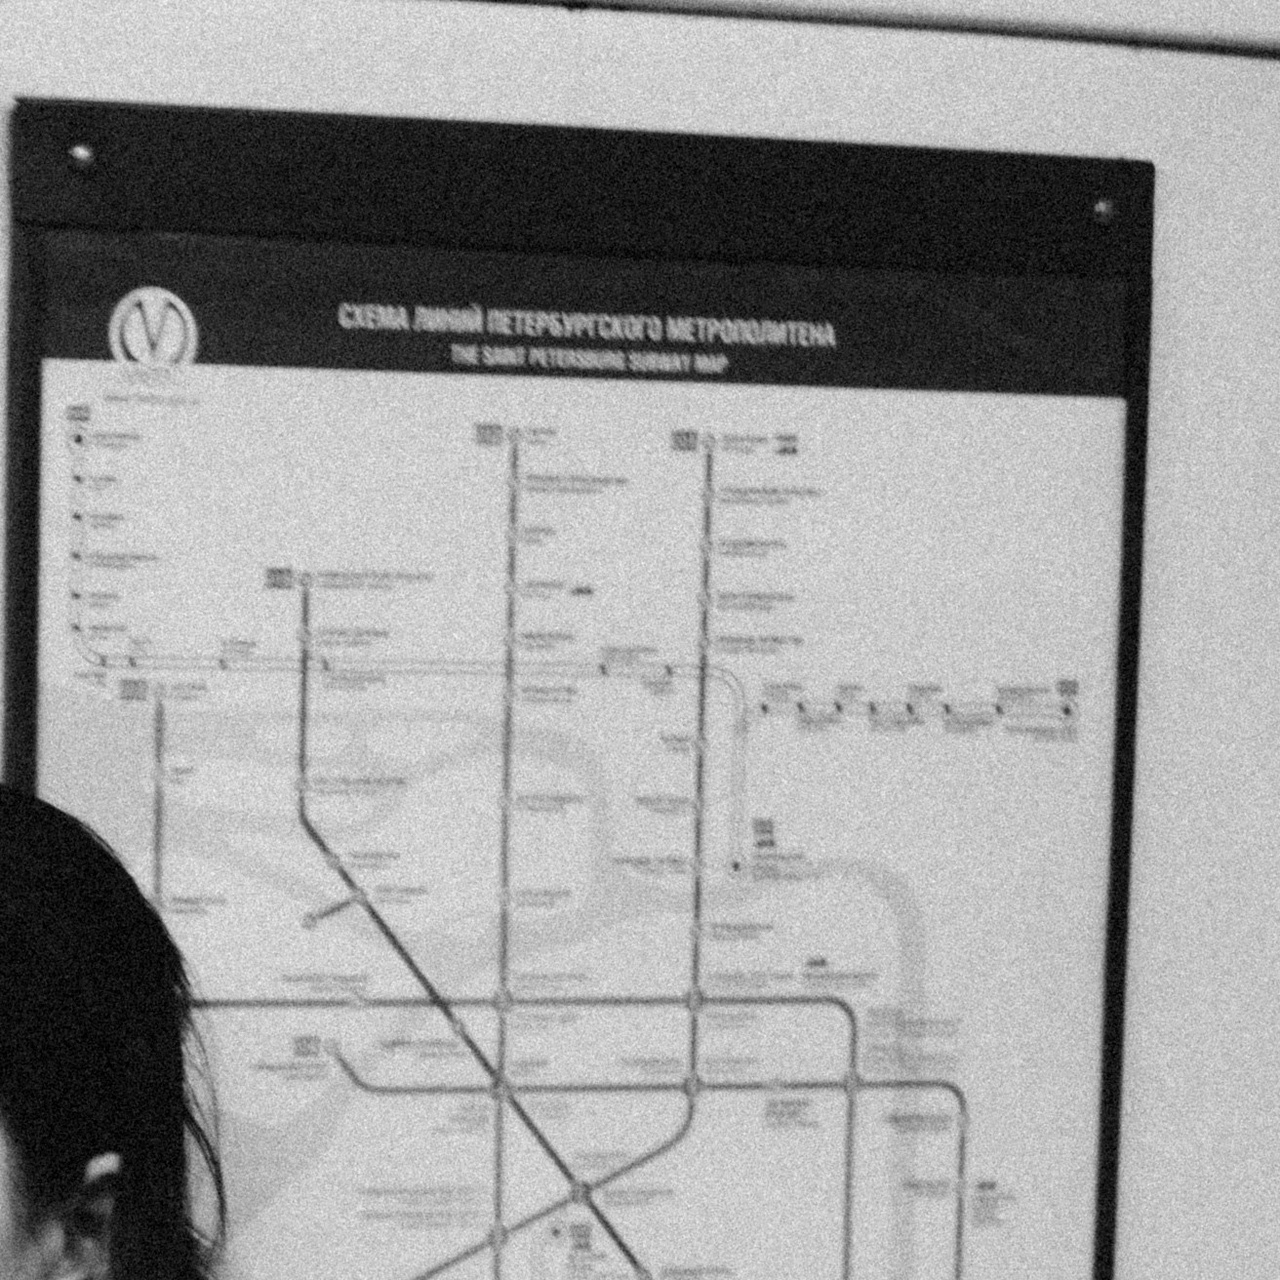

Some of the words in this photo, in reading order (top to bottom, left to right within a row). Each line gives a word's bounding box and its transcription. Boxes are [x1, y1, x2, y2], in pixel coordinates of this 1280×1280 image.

[338, 302, 409, 330] СХЕМА
[486, 308, 663, 343] ПЕТЕРБУРГСКОГО
[666, 315, 836, 349] МЕТРОПОЛИТЕНА
[450, 343, 478, 365] THE
